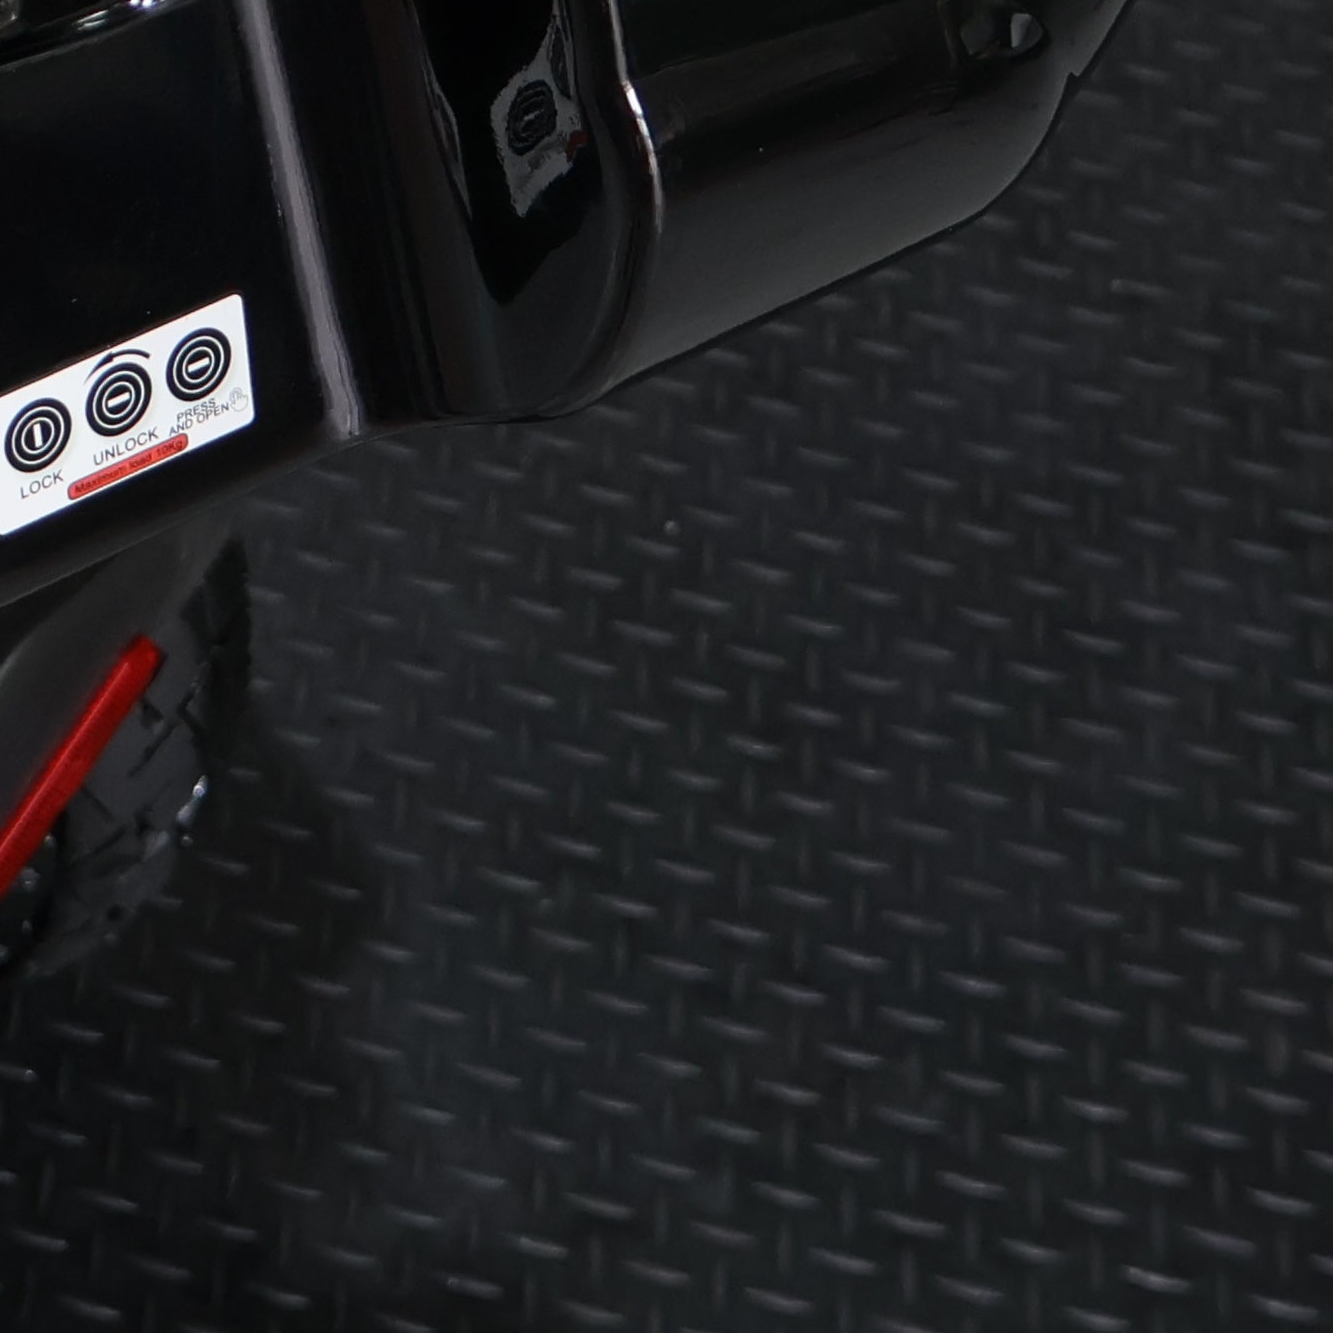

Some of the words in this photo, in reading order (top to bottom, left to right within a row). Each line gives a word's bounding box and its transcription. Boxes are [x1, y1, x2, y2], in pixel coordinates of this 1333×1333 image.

[169, 417, 194, 436] AND
[196, 402, 230, 425] OPEN
[177, 398, 216, 422] PRESS
[93, 426, 159, 466] UNLOCK
[20, 469, 64, 499] LOCK
[74, 465, 127, 495] Maximum
